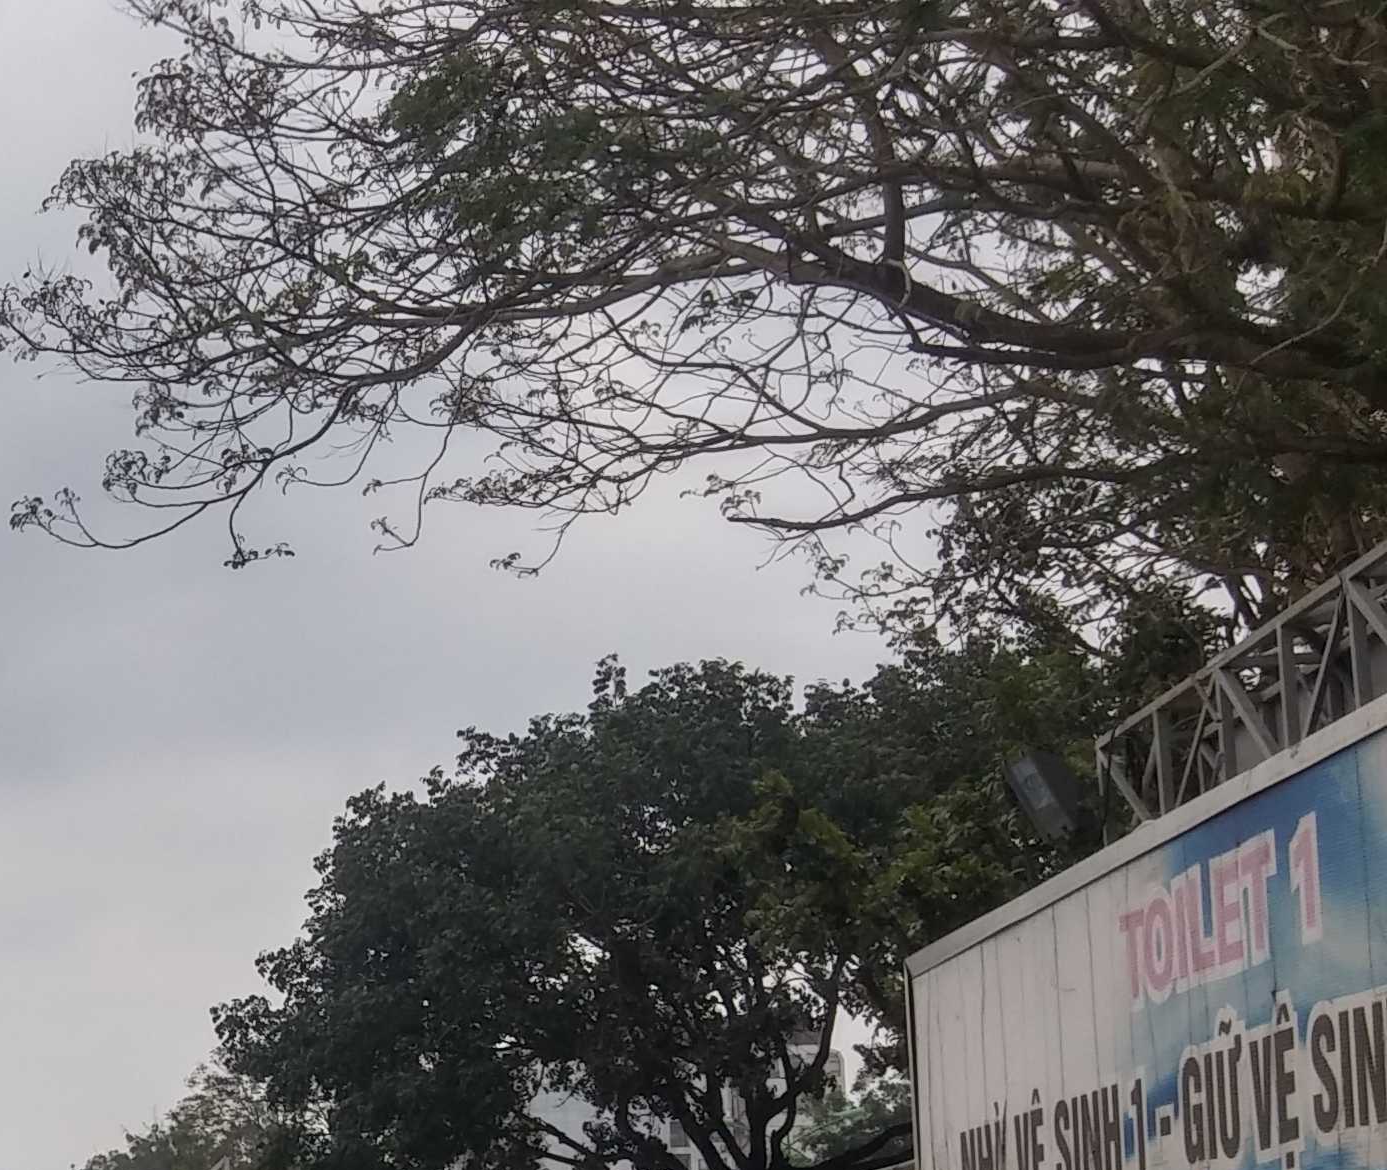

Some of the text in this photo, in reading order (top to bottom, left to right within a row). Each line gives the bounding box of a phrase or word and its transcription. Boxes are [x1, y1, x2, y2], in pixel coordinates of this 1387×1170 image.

[1119, 820, 1319, 1000] TOILET 1
[1182, 1019, 1242, 1165] GIỮ
[1249, 1002, 1299, 1170] VỆ
[1310, 1001, 1387, 1134] SIN
